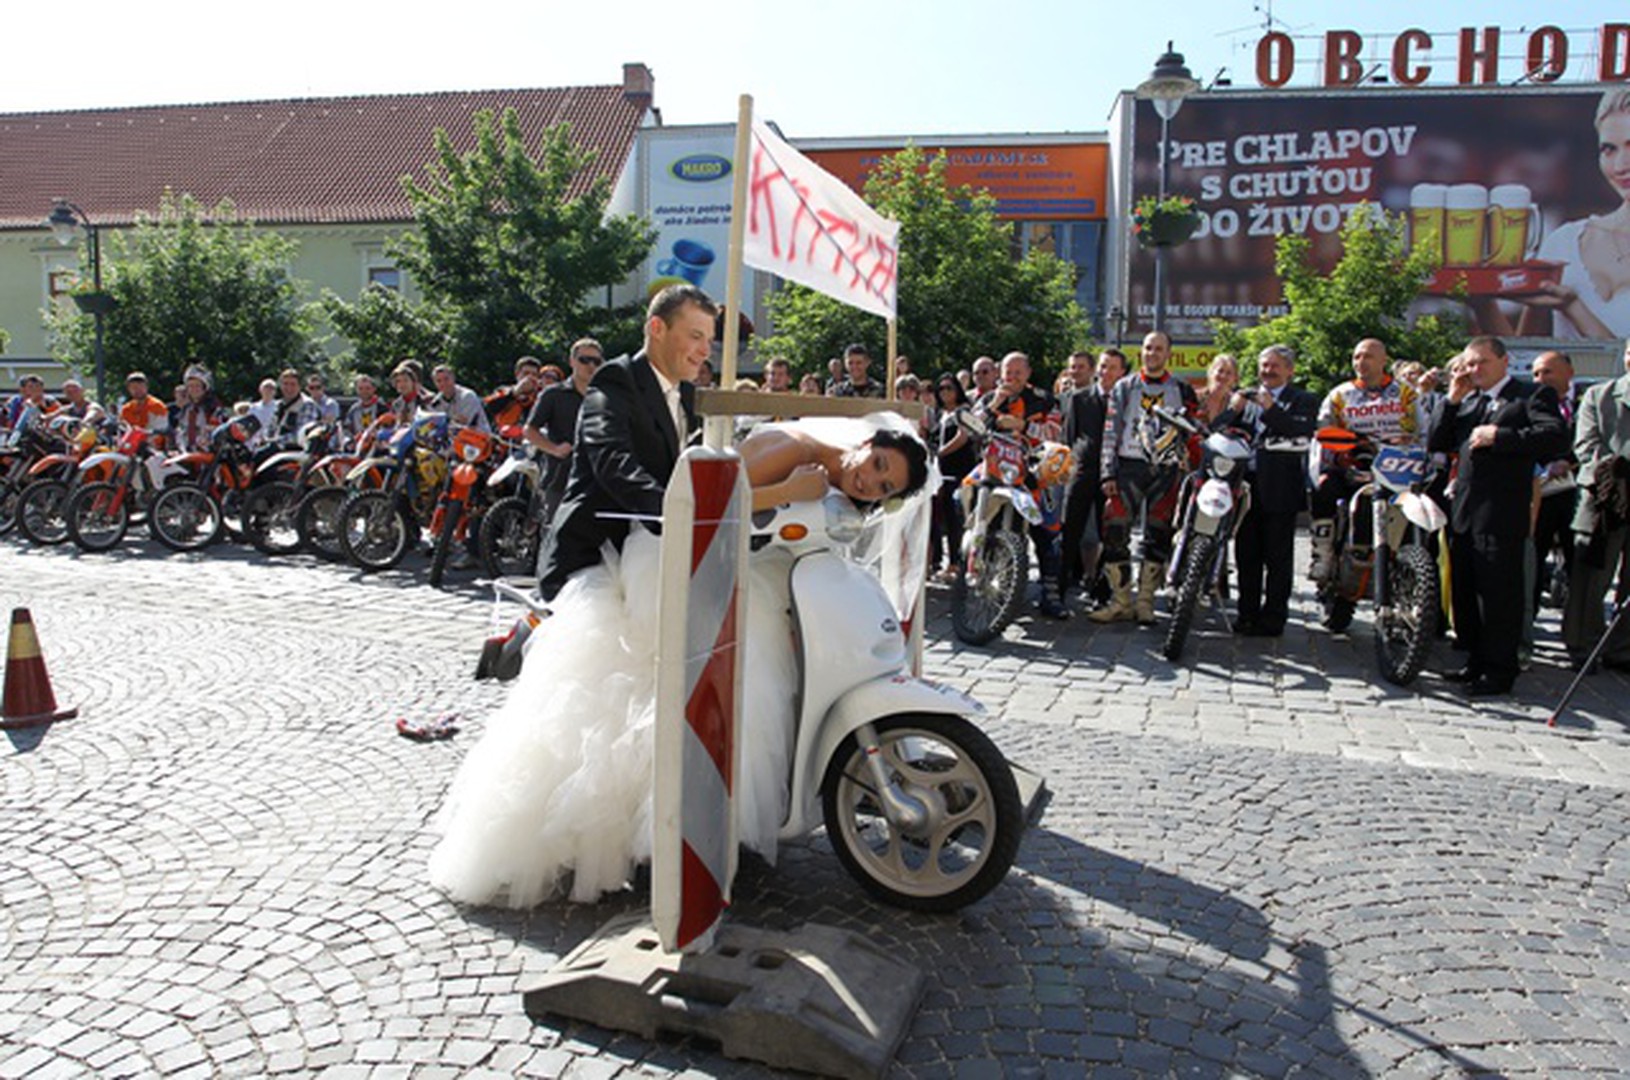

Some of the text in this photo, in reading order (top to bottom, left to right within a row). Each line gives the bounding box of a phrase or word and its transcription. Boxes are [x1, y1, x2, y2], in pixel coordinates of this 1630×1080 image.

[1255, 23, 1629, 89] OBCHOD
[1233, 125, 1417, 165] CHLAPOV
[1201, 164, 1373, 201] S CHUŤOU
